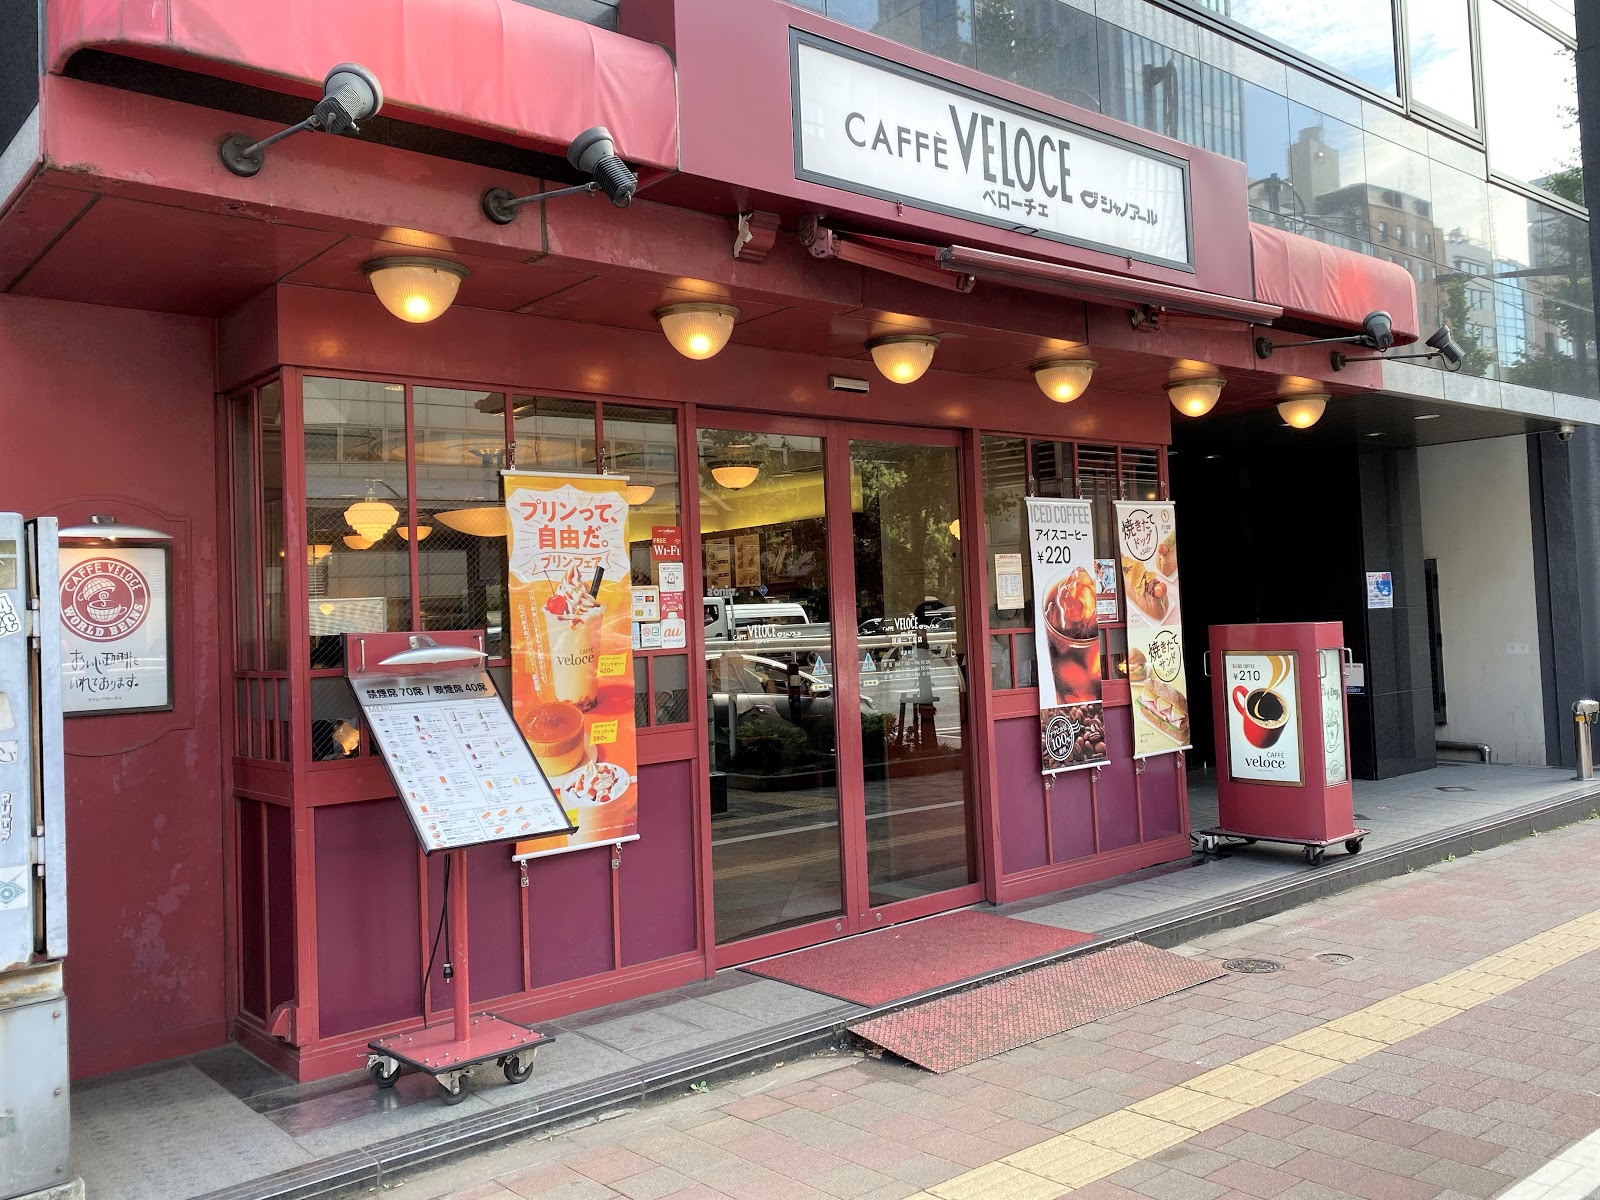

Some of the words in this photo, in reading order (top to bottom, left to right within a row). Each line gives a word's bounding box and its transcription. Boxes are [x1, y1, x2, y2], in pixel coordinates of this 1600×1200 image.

[844, 111, 949, 171] CAFFÈ
[948, 103, 1074, 204] VELOCE
[982, 190, 1049, 217] ベローチェ
[1100, 195, 1158, 226] シャノアール
[519, 498, 618, 524] プリンって、
[1030, 504, 1053, 524] ICED
[1054, 504, 1090, 525] COFFEE
[538, 524, 609, 550] 自由だ。
[1034, 528, 1088, 542] アイスコーヒー
[1121, 513, 1155, 541] 焼きたて
[653, 545, 681, 556] Wi-Fi
[1037, 545, 1071, 565] ¥220
[540, 554, 603, 570] プリンフェア
[107, 562, 142, 592] VELOCE
[62, 604, 105, 637] WORLD
[109, 602, 144, 636] BEANS
[893, 616, 919, 630] VELOCE
[663, 628, 682, 638] au
[746, 624, 776, 639] VELOCE
[1148, 633, 1179, 663] 焼きたて
[556, 653, 596, 666] veloce
[1232, 670, 1261, 681] ¥210
[1244, 755, 1287, 770] veloce
